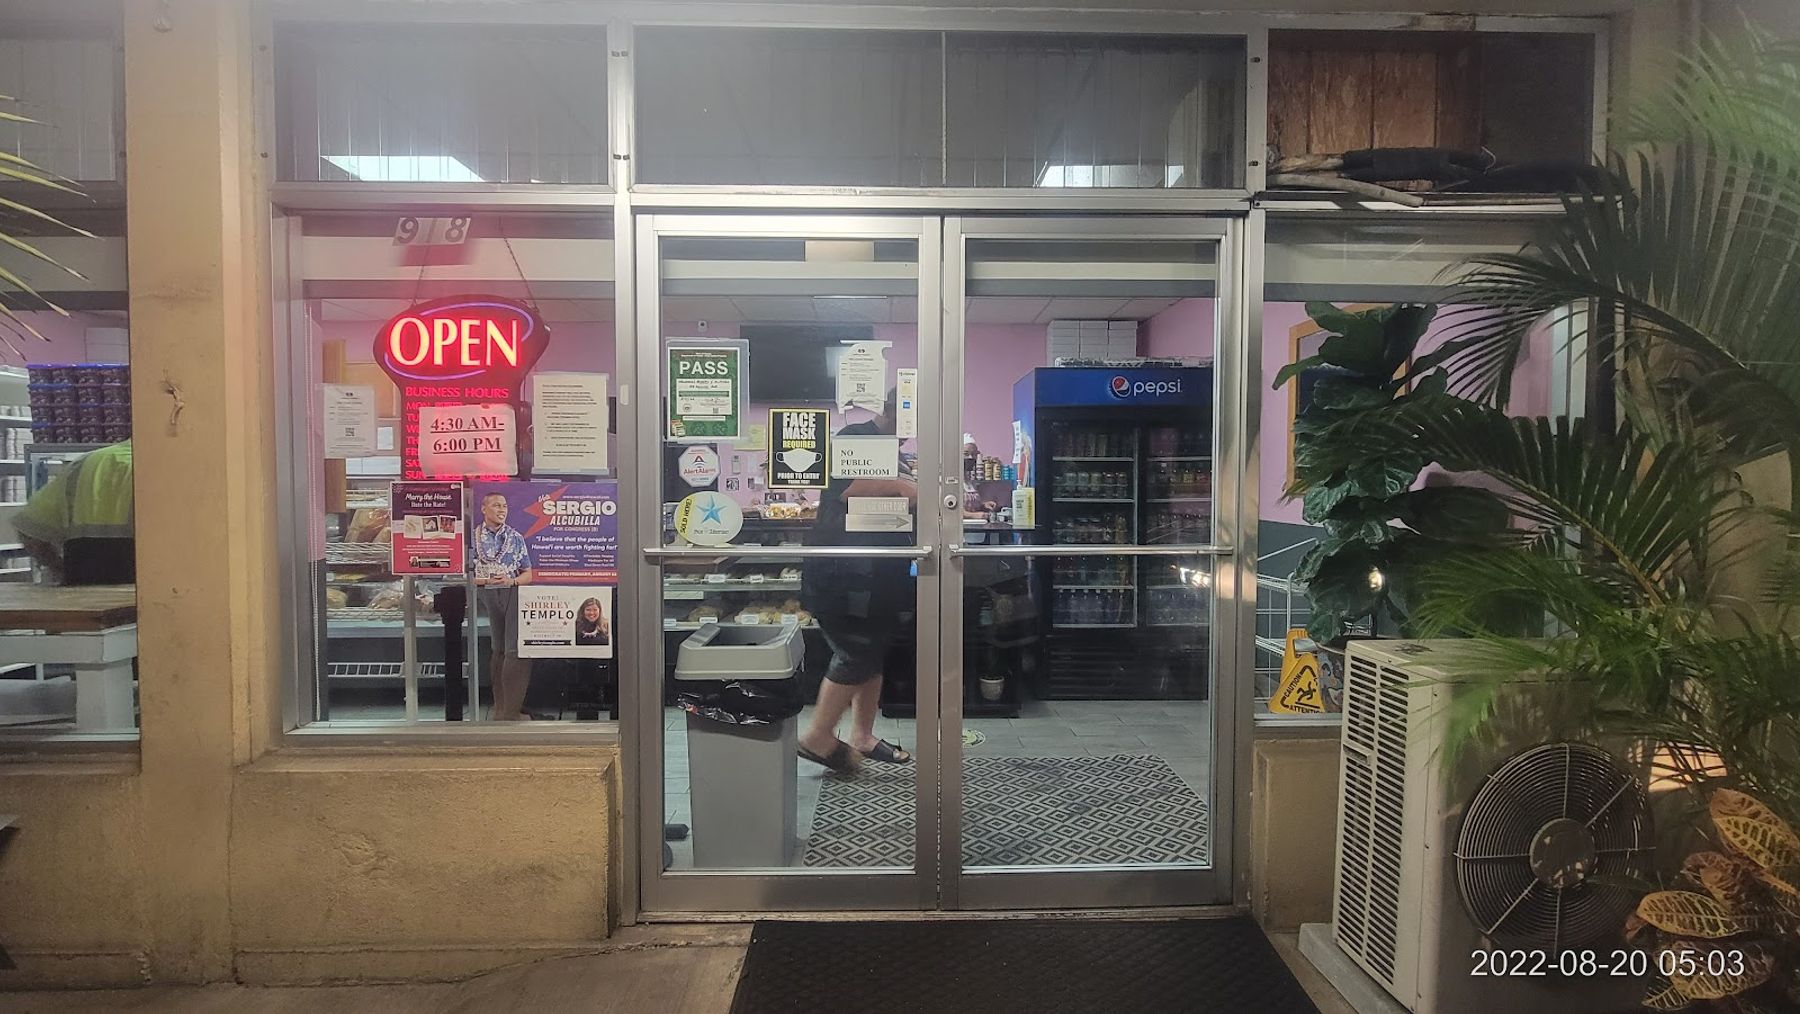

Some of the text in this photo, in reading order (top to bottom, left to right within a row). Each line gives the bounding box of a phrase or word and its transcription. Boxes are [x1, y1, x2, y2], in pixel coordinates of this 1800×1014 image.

[389, 317, 518, 367] OPEN
[679, 361, 729, 375] PASS
[405, 387, 509, 398] BUSINESS HOURS
[1133, 379, 1181, 397] pepsi
[431, 417, 463, 431] 4:30
[468, 416, 504, 430] AM-
[783, 412, 816, 428] FACE
[783, 427, 816, 440] MASK
[433, 437, 500, 451] 6:00 PM
[782, 440, 816, 449] REQUIRED
[840, 468, 890, 476] RESTROOM
[542, 500, 617, 516] SERGIO
[549, 515, 600, 526] ALCUBILLA
[524, 601, 570, 609] SHIRLEY
[521, 610, 574, 620] TEMPLO
[1284, 673, 1303, 698] CAUTION
[1289, 704, 1324, 714] ATTENTI
